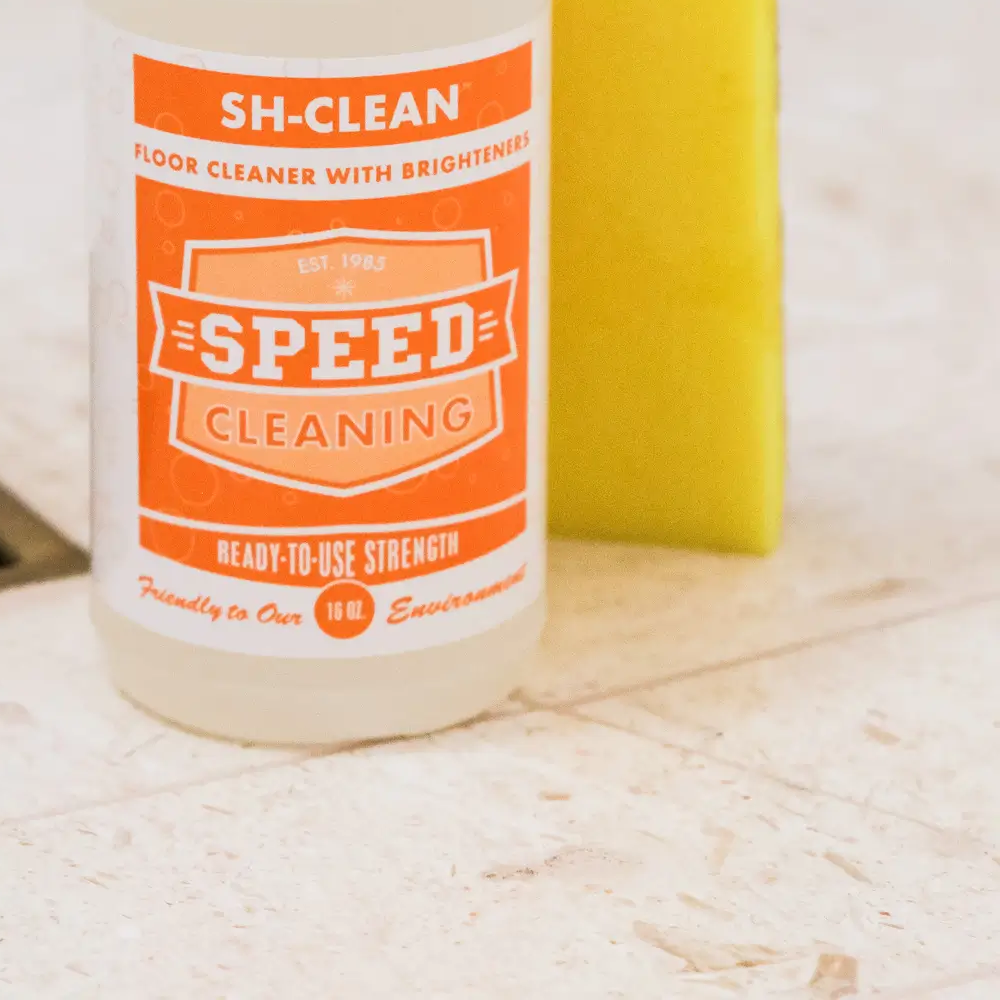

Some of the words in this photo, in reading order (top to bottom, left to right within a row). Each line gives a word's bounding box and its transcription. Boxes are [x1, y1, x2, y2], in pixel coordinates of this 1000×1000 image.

[220, 83, 459, 133] SH-CLEAN
[134, 143, 198, 175] FLOOR
[207, 160, 316, 185] CLEANER
[326, 165, 392, 184] WITH
[402, 131, 530, 180] BRIGHTENERS
[297, 254, 335, 275] EST.
[341, 253, 387, 272] 1985
[200, 301, 474, 381] SPEED
[204, 396, 474, 448] CLEANING
[363, 531, 459, 576] STRENGTH
[138, 575, 223, 622] Friendly
[227, 604, 248, 621] to
[256, 602, 303, 626] Our
